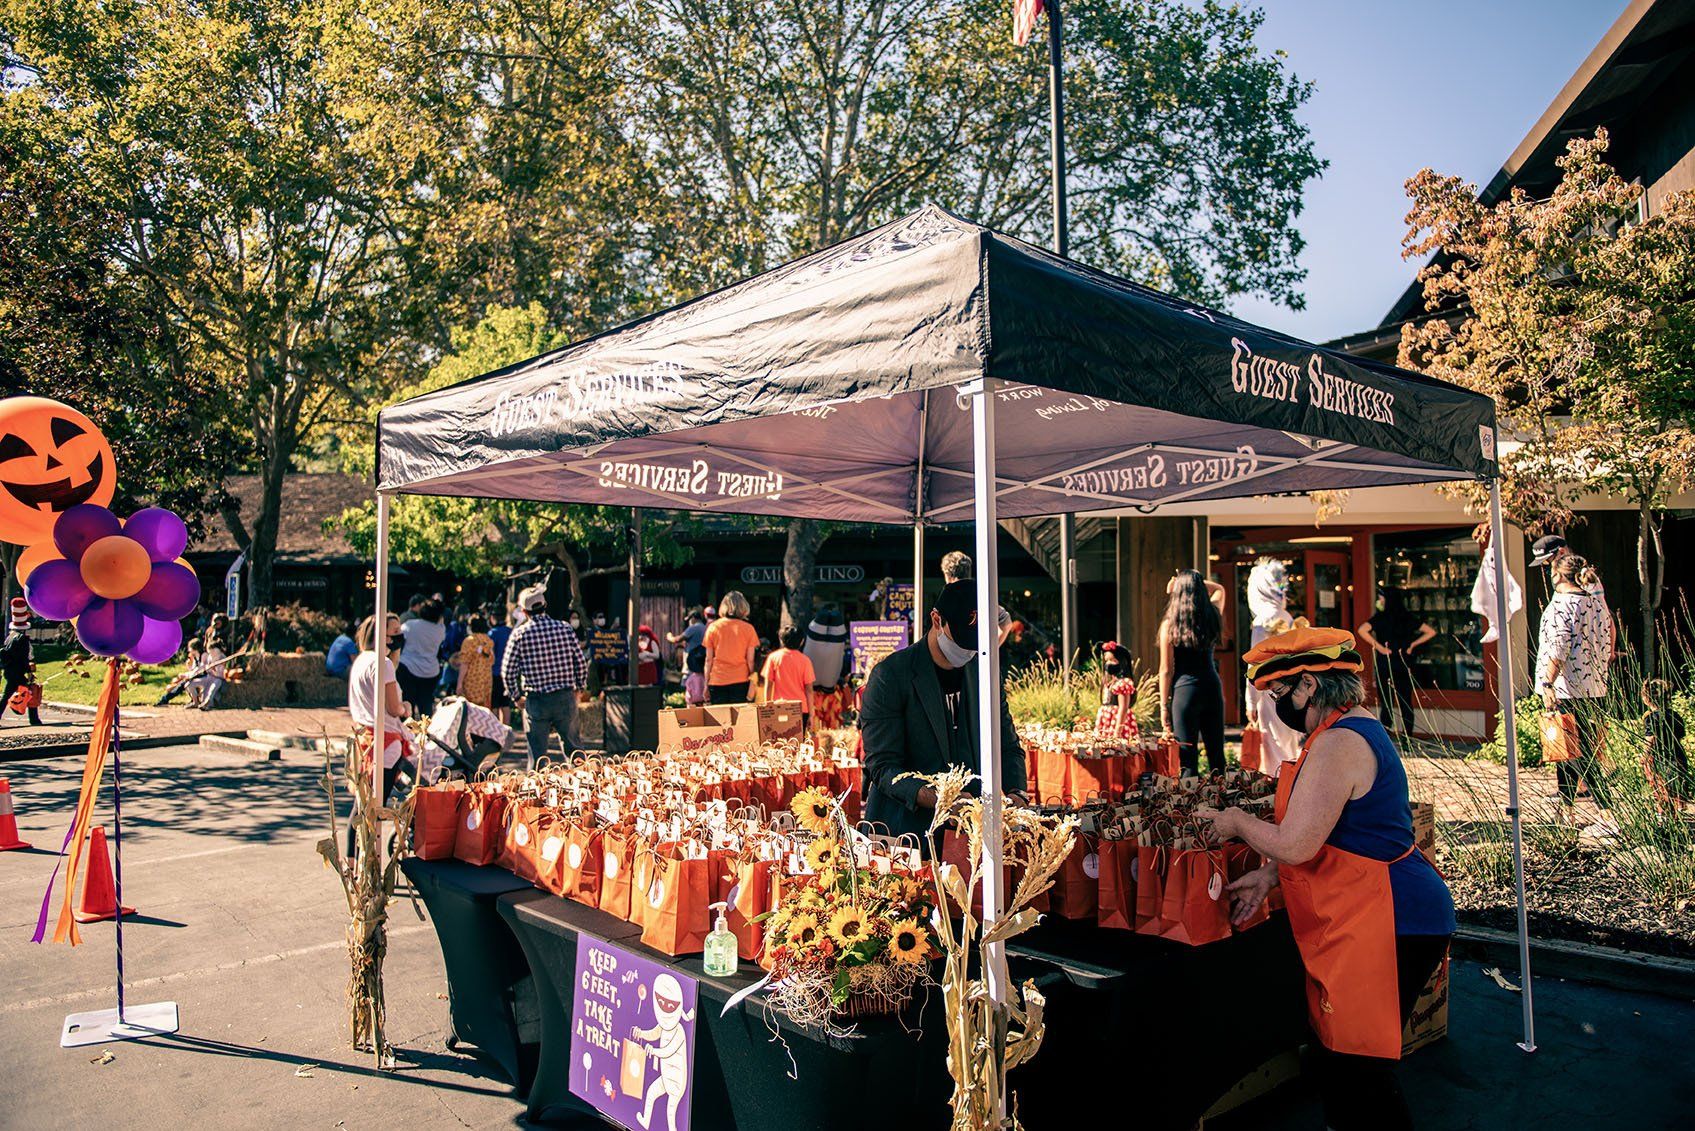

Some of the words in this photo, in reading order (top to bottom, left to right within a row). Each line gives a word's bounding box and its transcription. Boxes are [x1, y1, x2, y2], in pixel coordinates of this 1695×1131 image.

[490, 389, 557, 437] GUEST
[562, 360, 685, 419] SERVICES
[1231, 337, 1301, 403] GUEST
[1308, 353, 1395, 425] SERVICES
[588, 947, 618, 975] KEEP
[582, 970, 591, 990] 6
[590, 975, 622, 1009] FEET,
[583, 998, 613, 1033] TAKE
[576, 1018, 584, 1038] A
[585, 1024, 621, 1058] TREAT
